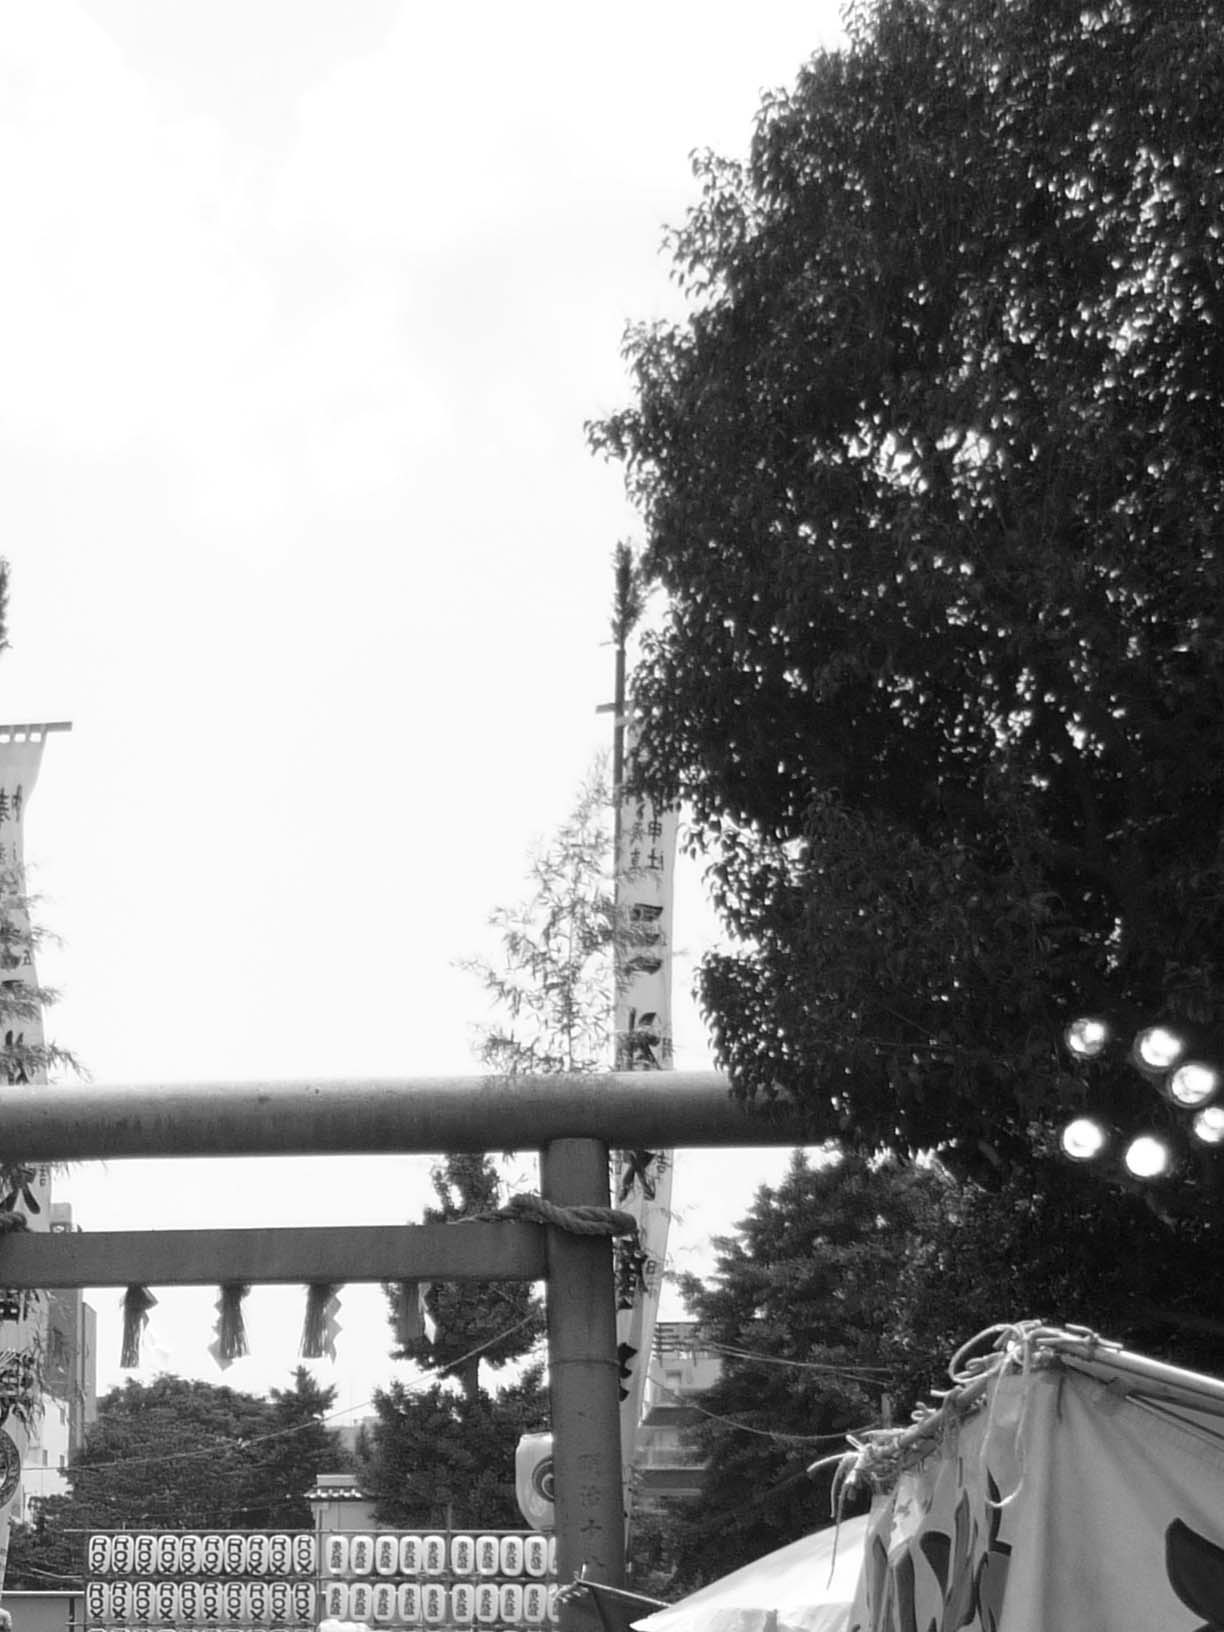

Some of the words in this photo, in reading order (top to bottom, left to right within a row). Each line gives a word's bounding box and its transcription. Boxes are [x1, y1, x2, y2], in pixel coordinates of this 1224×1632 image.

[91, 1538, 107, 1573] ROX
[113, 1537, 129, 1572] ROX
[138, 1538, 153, 1573] ROX
[161, 1538, 176, 1573] ROX
[181, 1538, 197, 1573] ROX
[204, 1538, 219, 1573] ROX
[227, 1538, 243, 1573] ROX
[248, 1537, 263, 1573] ROX
[272, 1537, 287, 1573] ROX
[297, 1537, 312, 1572] ROX
[89, 1583, 104, 1620] ROX
[112, 1583, 127, 1620] ROX
[135, 1583, 150, 1620] ROX
[159, 1583, 174, 1620] ROX
[181, 1583, 196, 1620] ROX
[203, 1583, 218, 1620] ROX
[227, 1583, 242, 1620] ROX
[249, 1583, 264, 1620] ROX
[272, 1583, 287, 1620] ROX
[294, 1583, 310, 1620] ROX
